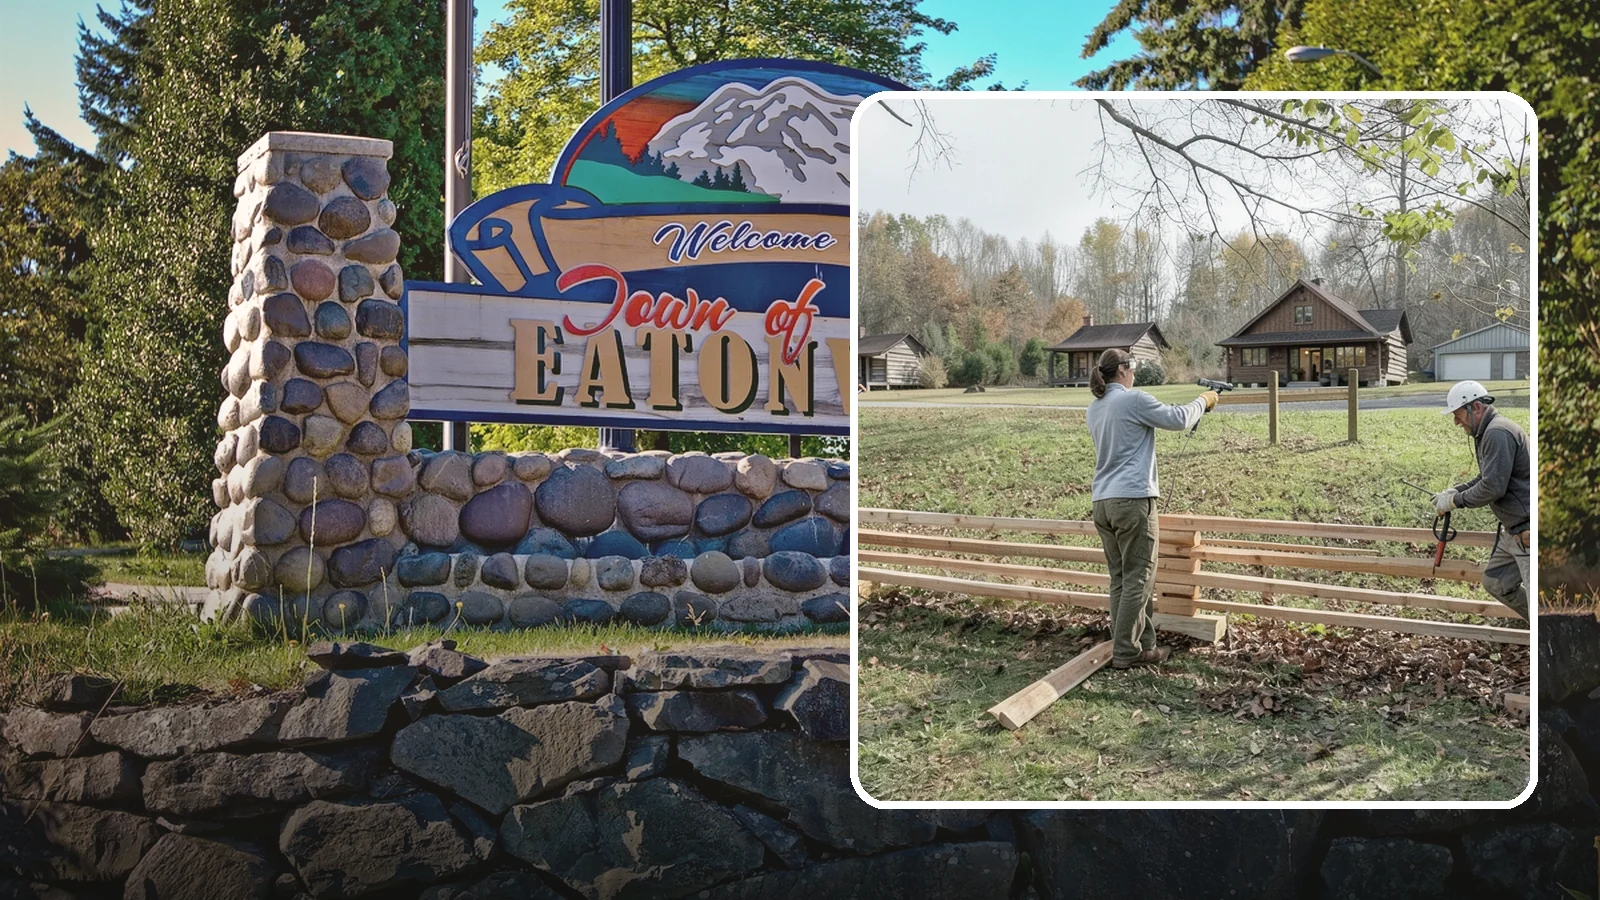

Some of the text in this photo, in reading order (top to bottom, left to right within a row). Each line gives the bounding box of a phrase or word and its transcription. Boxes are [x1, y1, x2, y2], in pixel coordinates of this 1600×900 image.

[654, 221, 836, 263] Welcome
[557, 264, 826, 365] Town of
